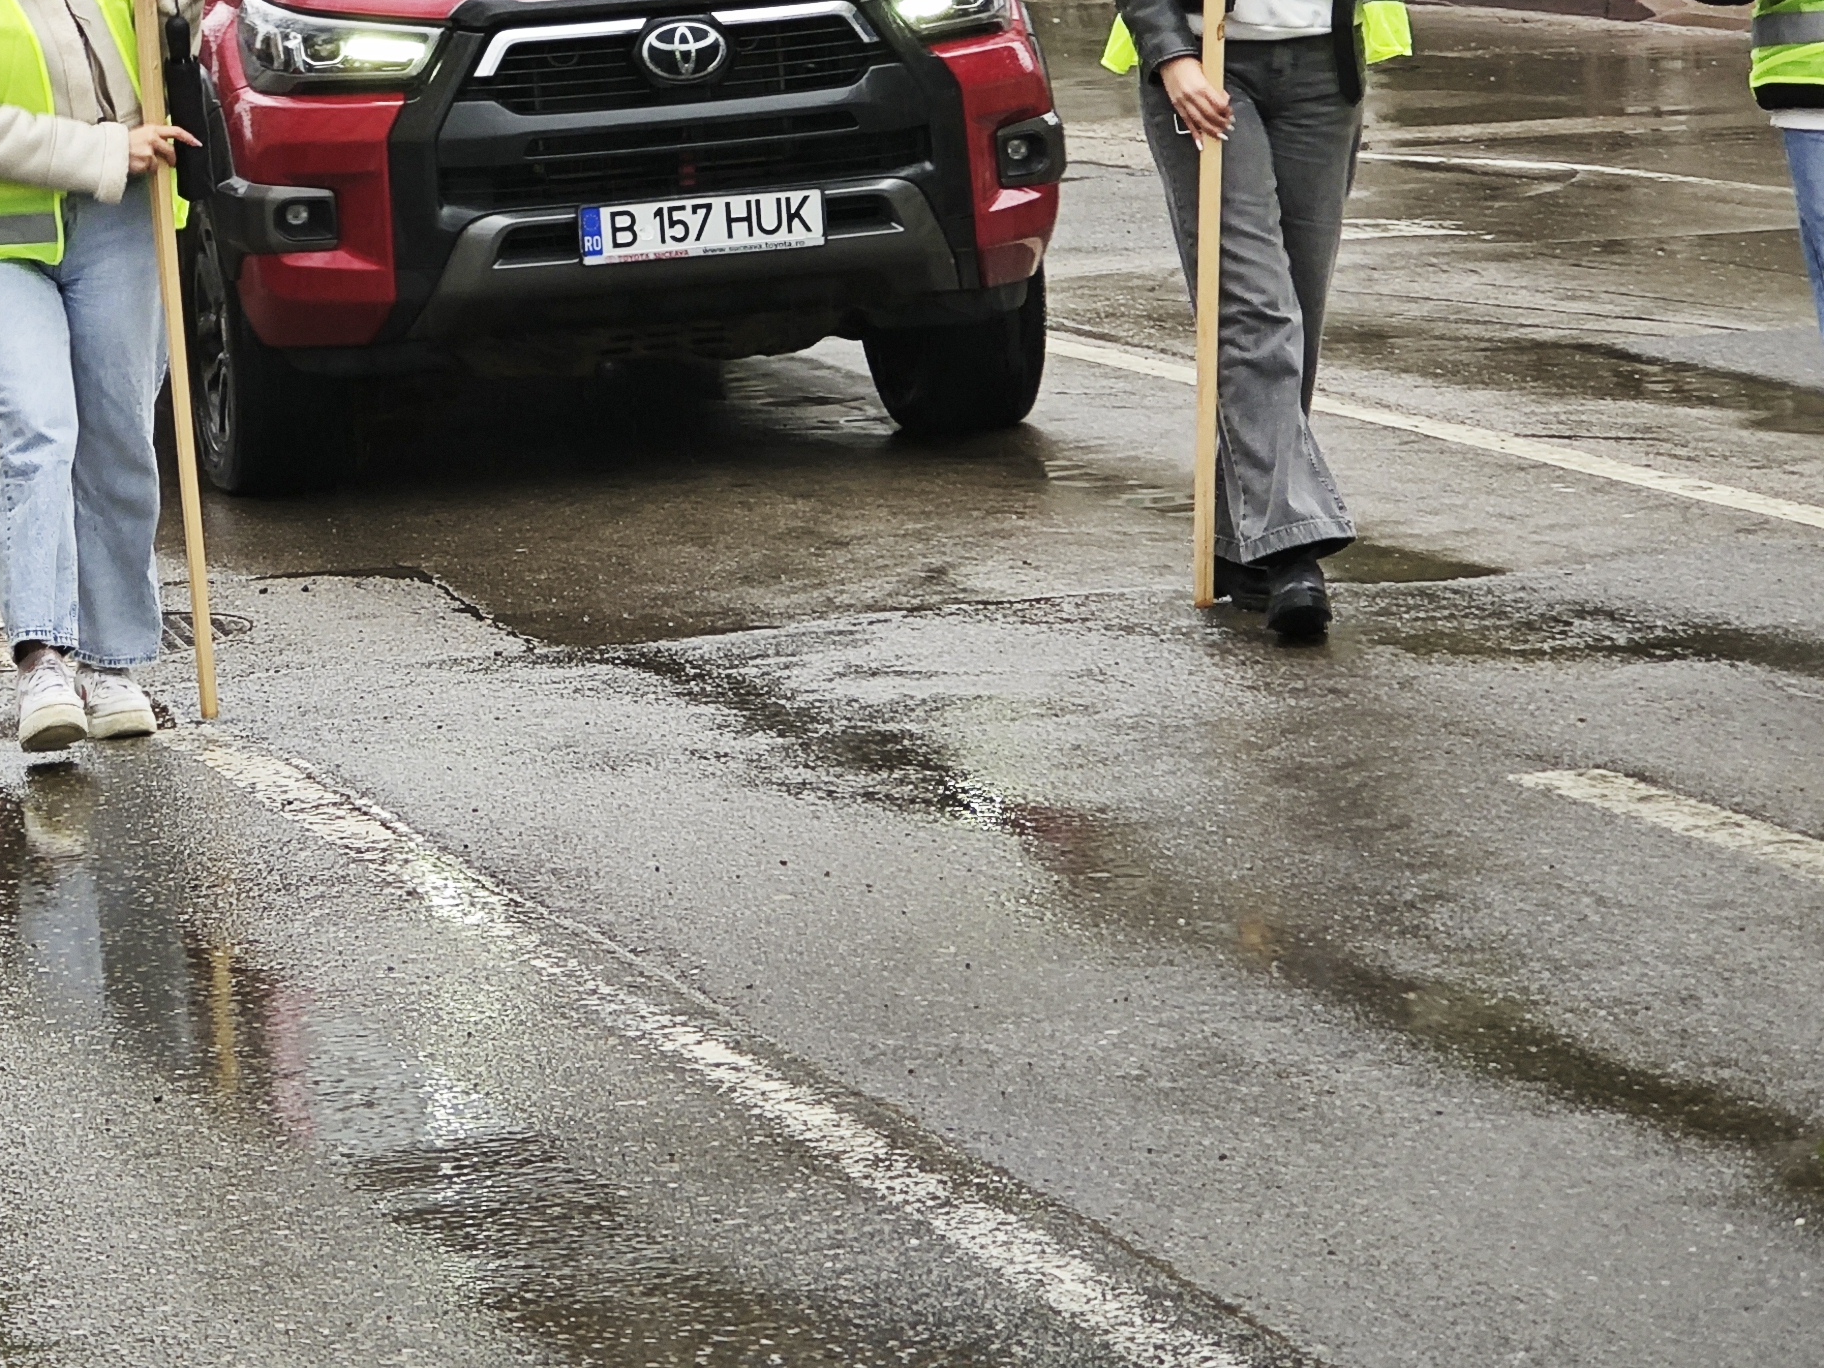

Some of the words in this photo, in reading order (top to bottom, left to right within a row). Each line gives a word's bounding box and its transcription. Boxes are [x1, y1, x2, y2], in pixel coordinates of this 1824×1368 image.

[609, 209, 638, 249] B
[652, 202, 713, 245] 157
[724, 194, 813, 240] HUK
[583, 235, 602, 252] RO
[617, 253, 650, 263] TOYOTA
[653, 249, 689, 260] SUCEAVA
